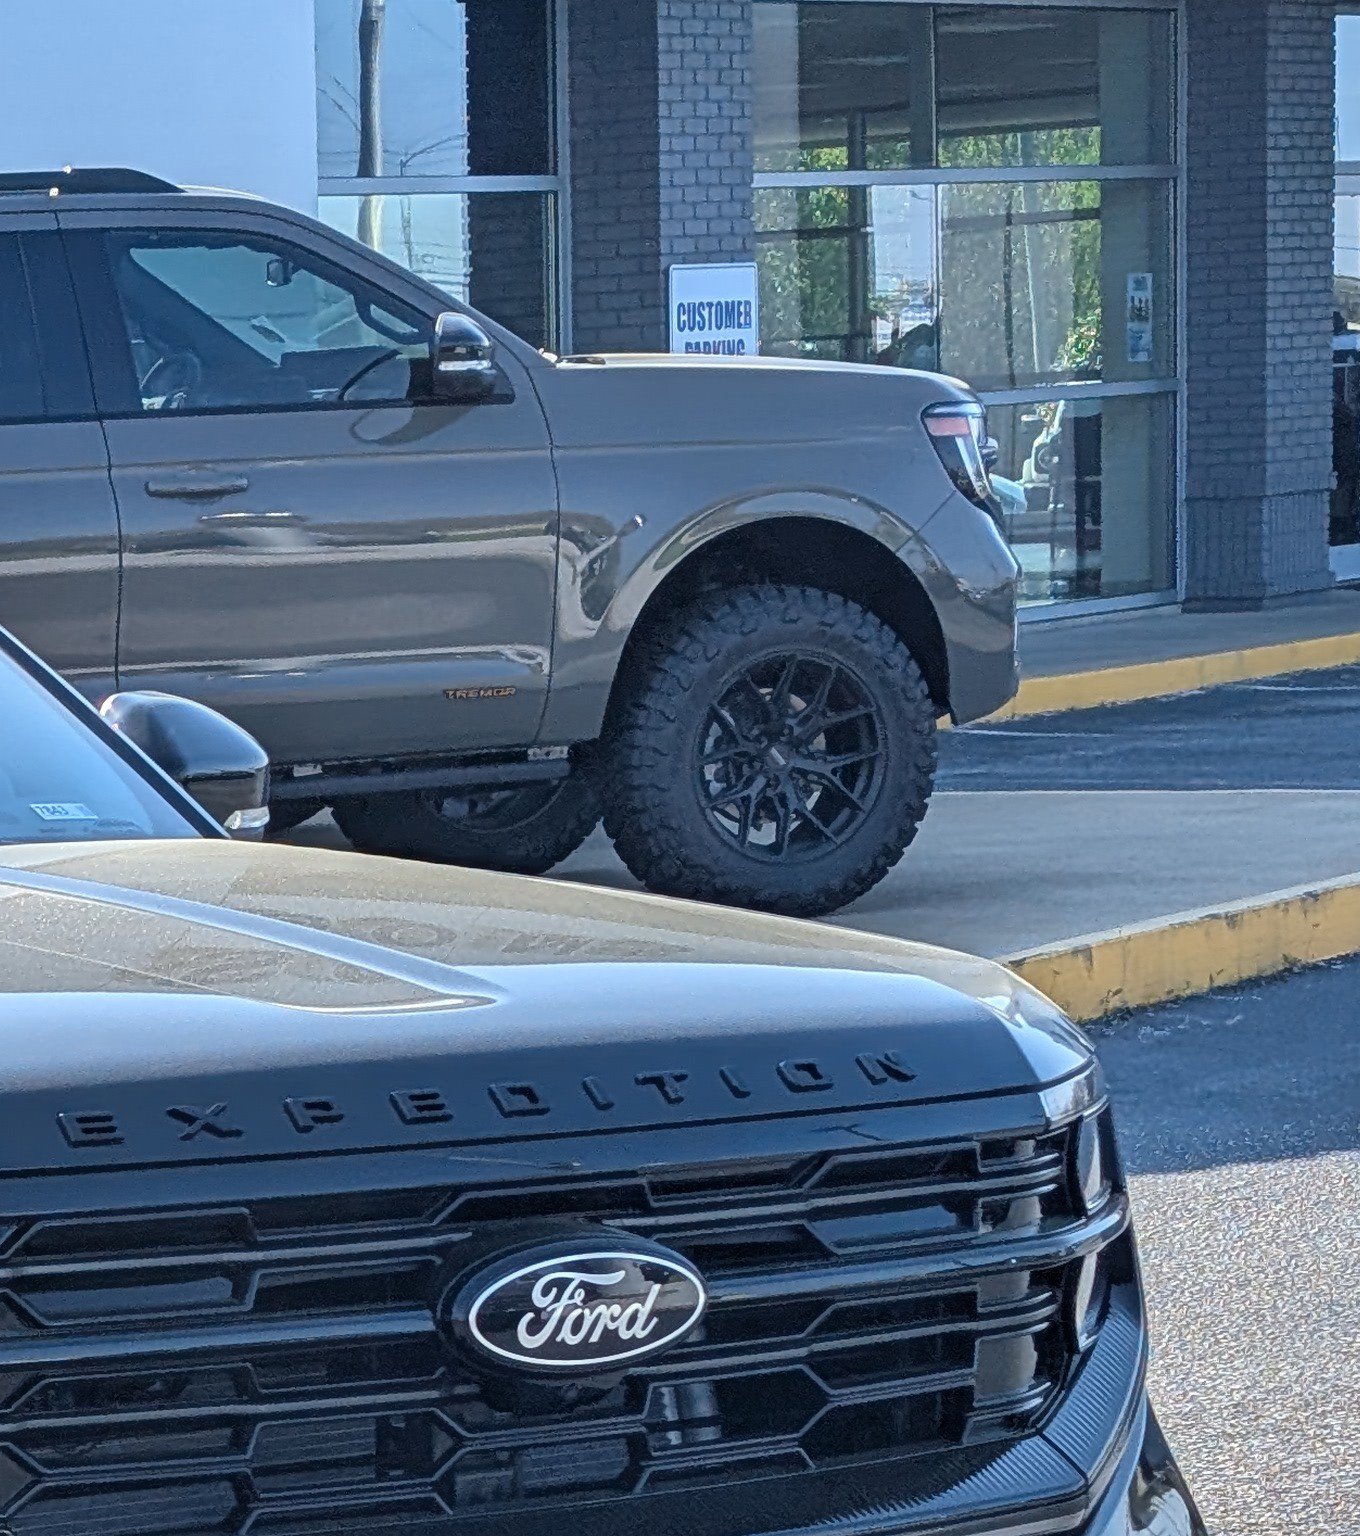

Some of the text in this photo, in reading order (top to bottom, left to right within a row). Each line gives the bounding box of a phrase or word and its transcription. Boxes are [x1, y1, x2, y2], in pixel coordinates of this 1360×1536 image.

[676, 299, 752, 332] CUSTOMER
[443, 686, 517, 700] TREMOR
[56, 1050, 918, 1148] EXPEDITION
[517, 1270, 660, 1349] Ford
